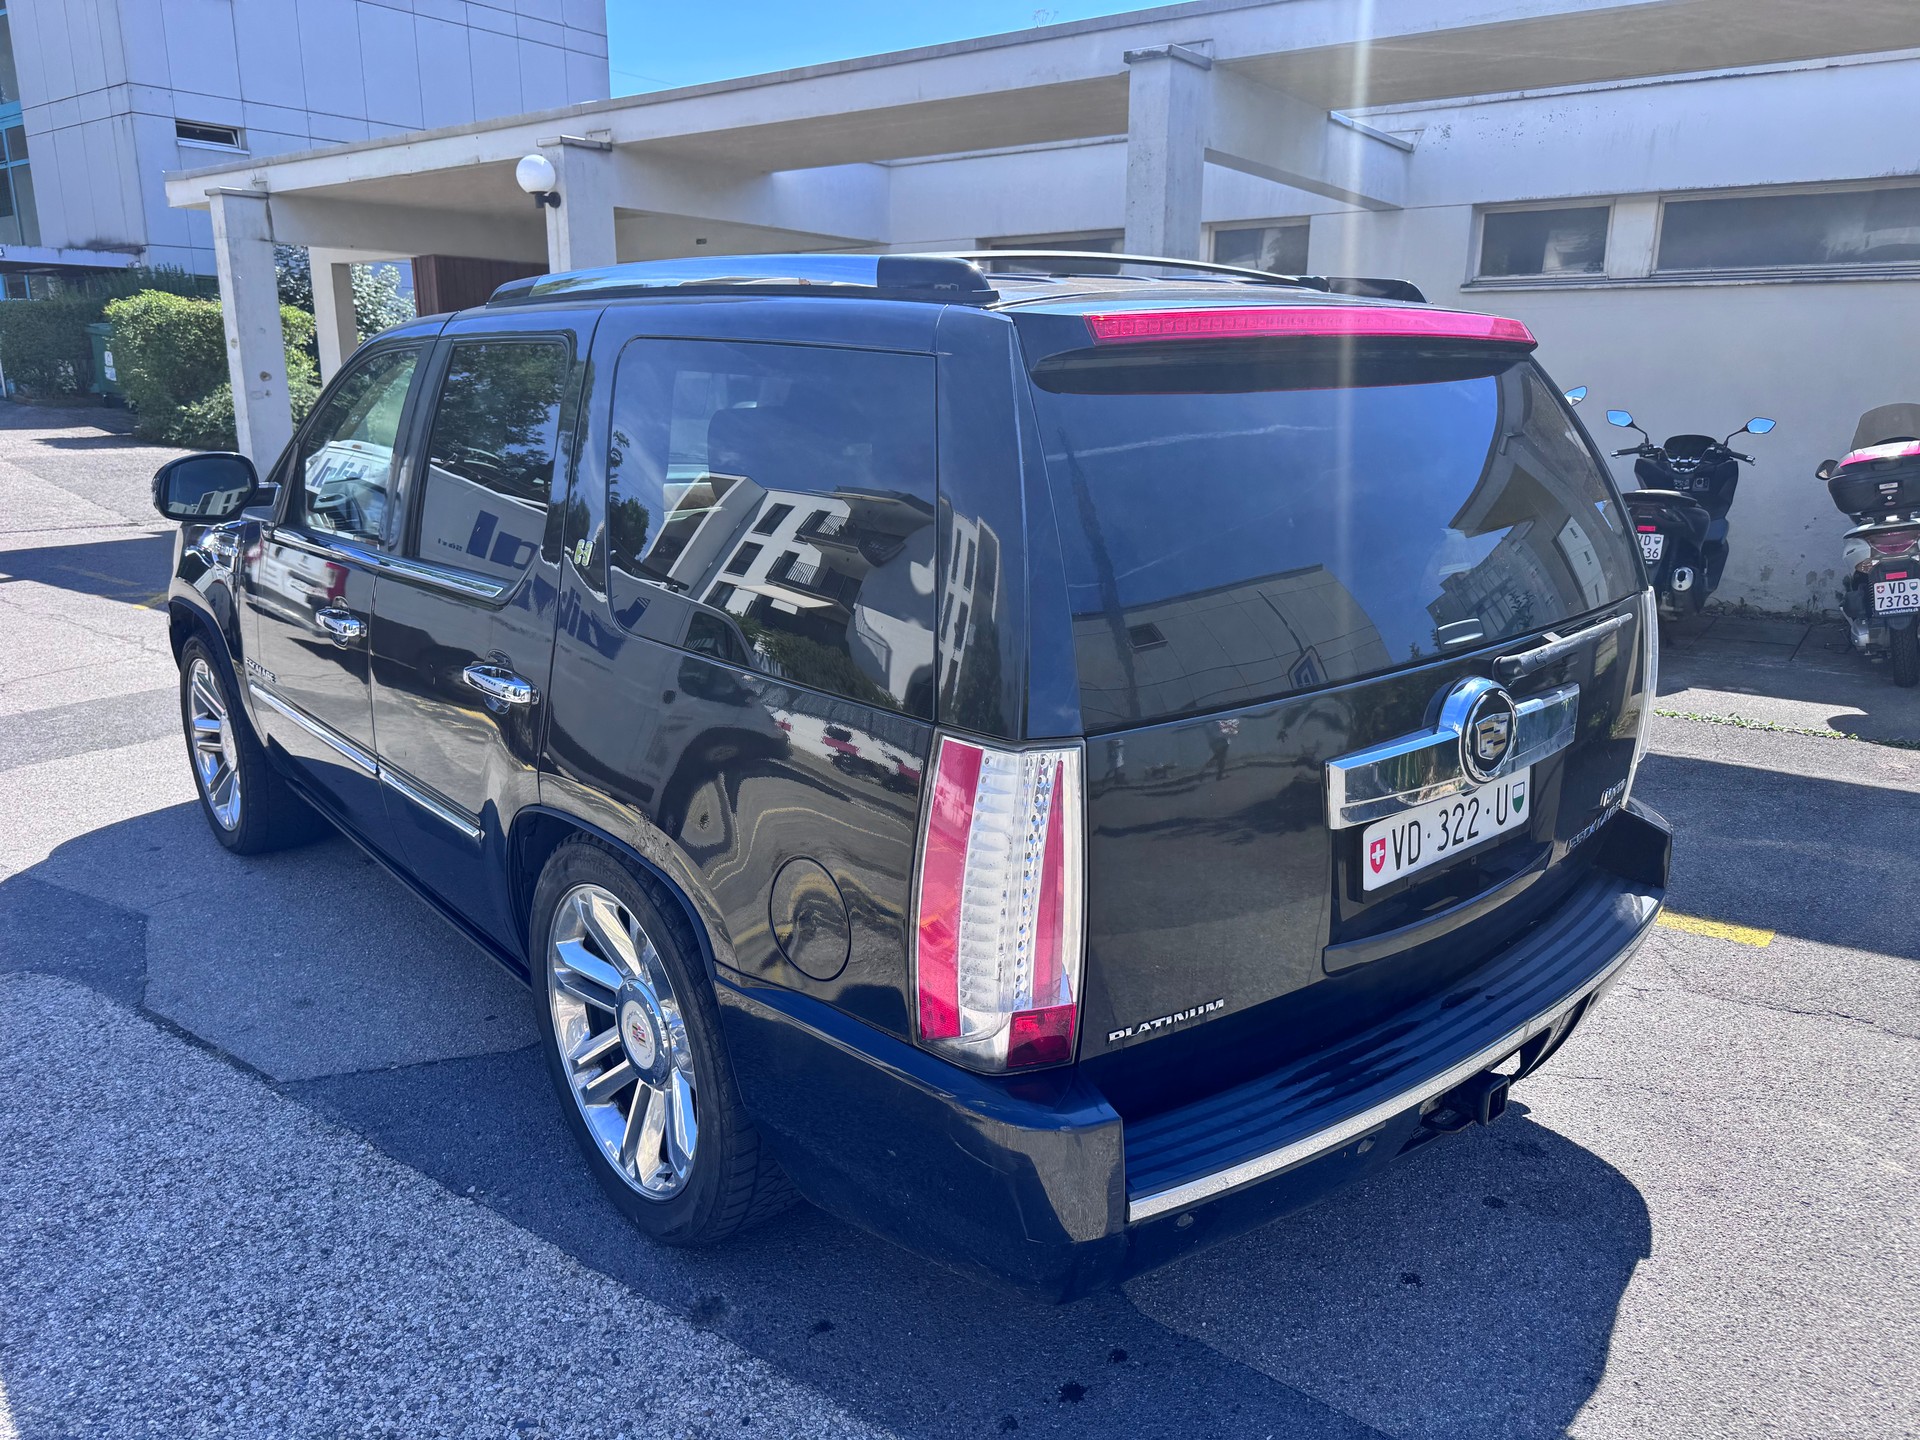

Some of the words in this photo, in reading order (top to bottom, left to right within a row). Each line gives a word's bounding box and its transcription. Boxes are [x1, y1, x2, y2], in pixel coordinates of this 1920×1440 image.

[1644, 547, 1659, 559] 36
[1888, 581, 1906, 595] VD
[1876, 593, 1919, 609] 73783
[1107, 998, 1225, 1042] PLATINUM
